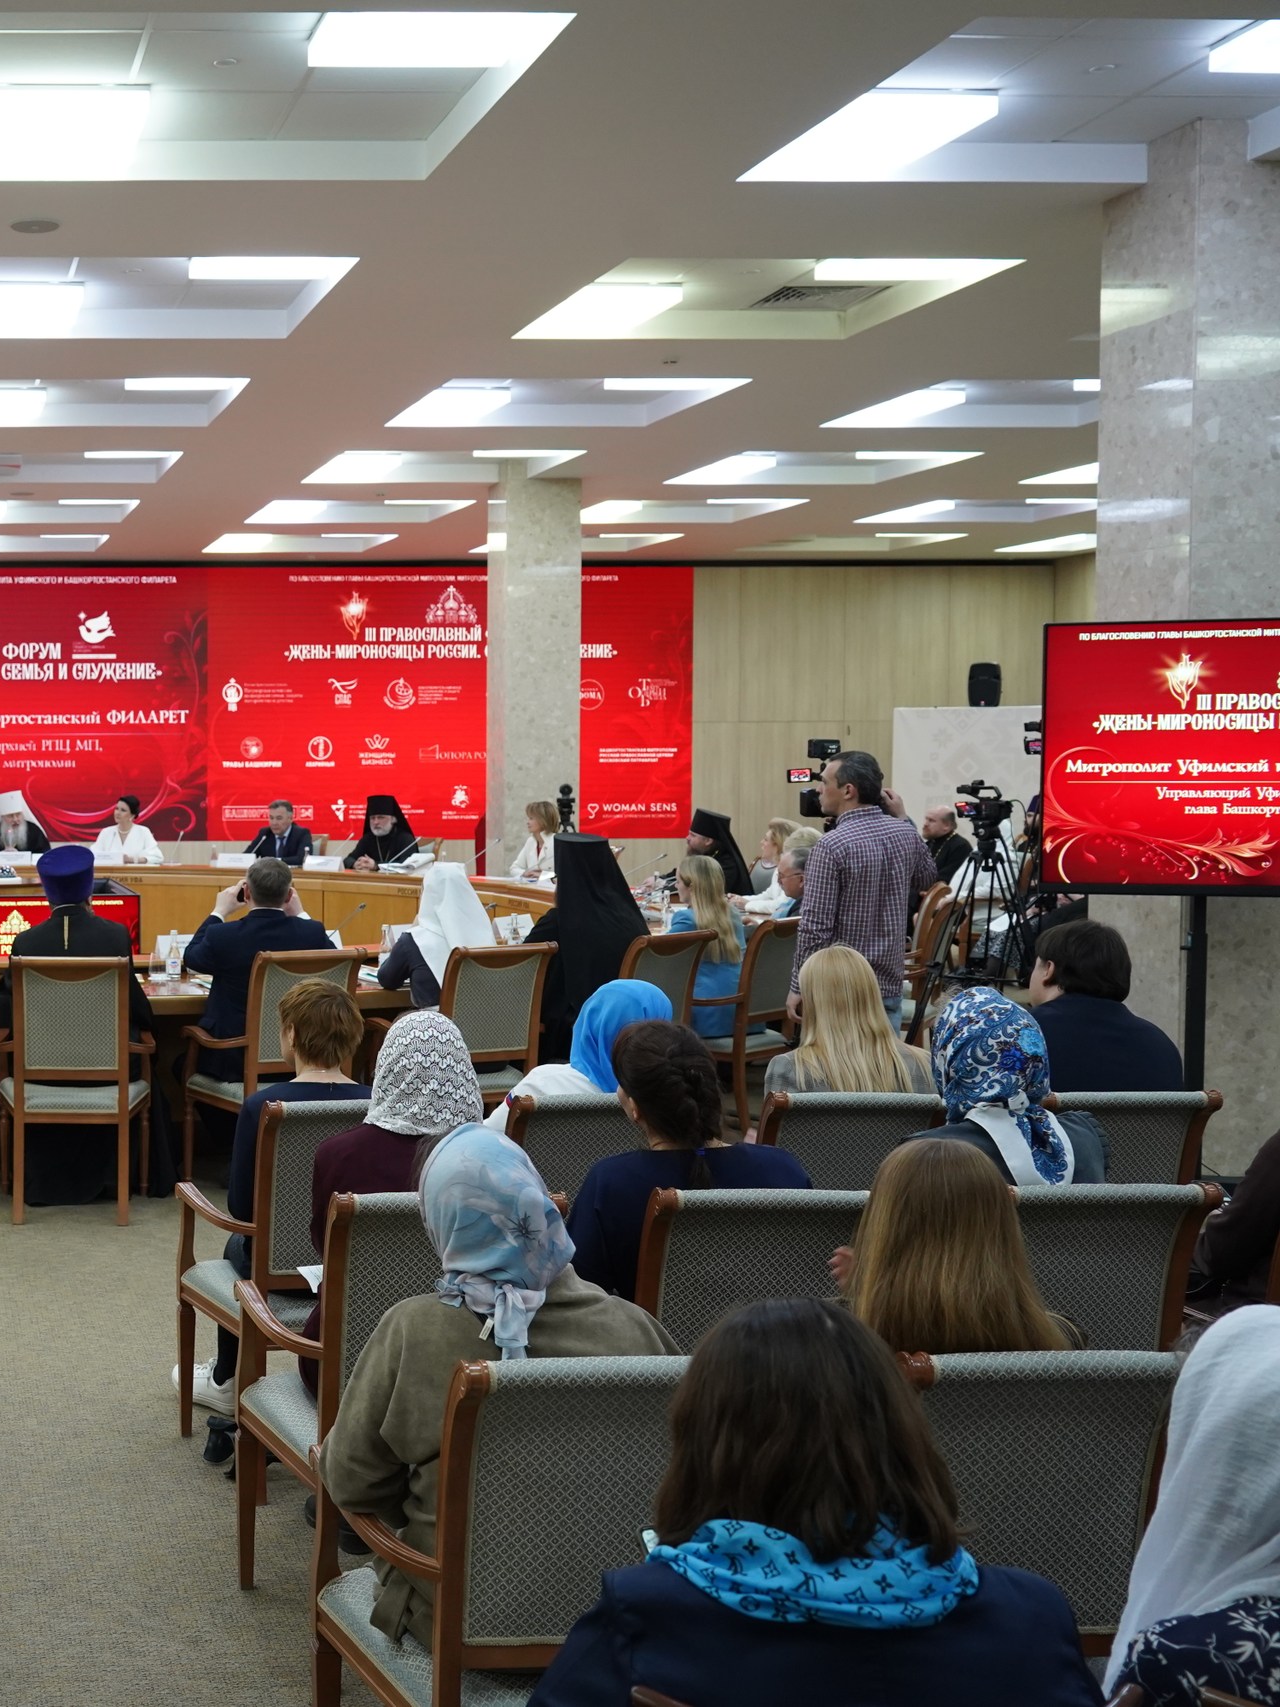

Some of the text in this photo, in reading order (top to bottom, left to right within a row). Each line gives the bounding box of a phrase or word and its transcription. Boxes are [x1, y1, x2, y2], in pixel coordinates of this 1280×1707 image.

[141, 576, 177, 584] ФИЛАРЕТА
[365, 624, 482, 642] III ПРАВОСЛАВНЫЙ
[1079, 633, 1091, 641] ПО
[1091, 631, 1155, 640] БЛАГОСЛОВЕНИЮ
[1157, 630, 1182, 639] ГЛАВЫ
[1184, 628, 1262, 639] БАШКОРТОСТАНСКОЙ
[2, 643, 61, 660] ФОРУМ
[284, 644, 481, 662] «ЖЕНЫ-МИРОНОСИЦЫ РОССИИ.
[580, 643, 618, 658] ЕНИЕ»
[1, 663, 54, 682] СЕМЬЯ
[58, 663, 68, 680] И
[72, 662, 163, 683] СЛУЖЕНИЕ»
[1196, 693, 1280, 710] III ПРАВОС
[106, 709, 189, 725] ФИЛАРЕТ
[1092, 713, 1275, 734] «ЖЕНЫ-МИРОНОСИЦЫ
[41, 739, 70, 754] РПЦ
[75, 739, 103, 752] МП,
[3, 758, 76, 771] митрополии
[1065, 759, 1269, 776] Митрополит Уфимский
[1156, 786, 1251, 801] Управляющий
[603, 803, 677, 812] WOMAN SENS
[1184, 805, 1217, 814] глава
